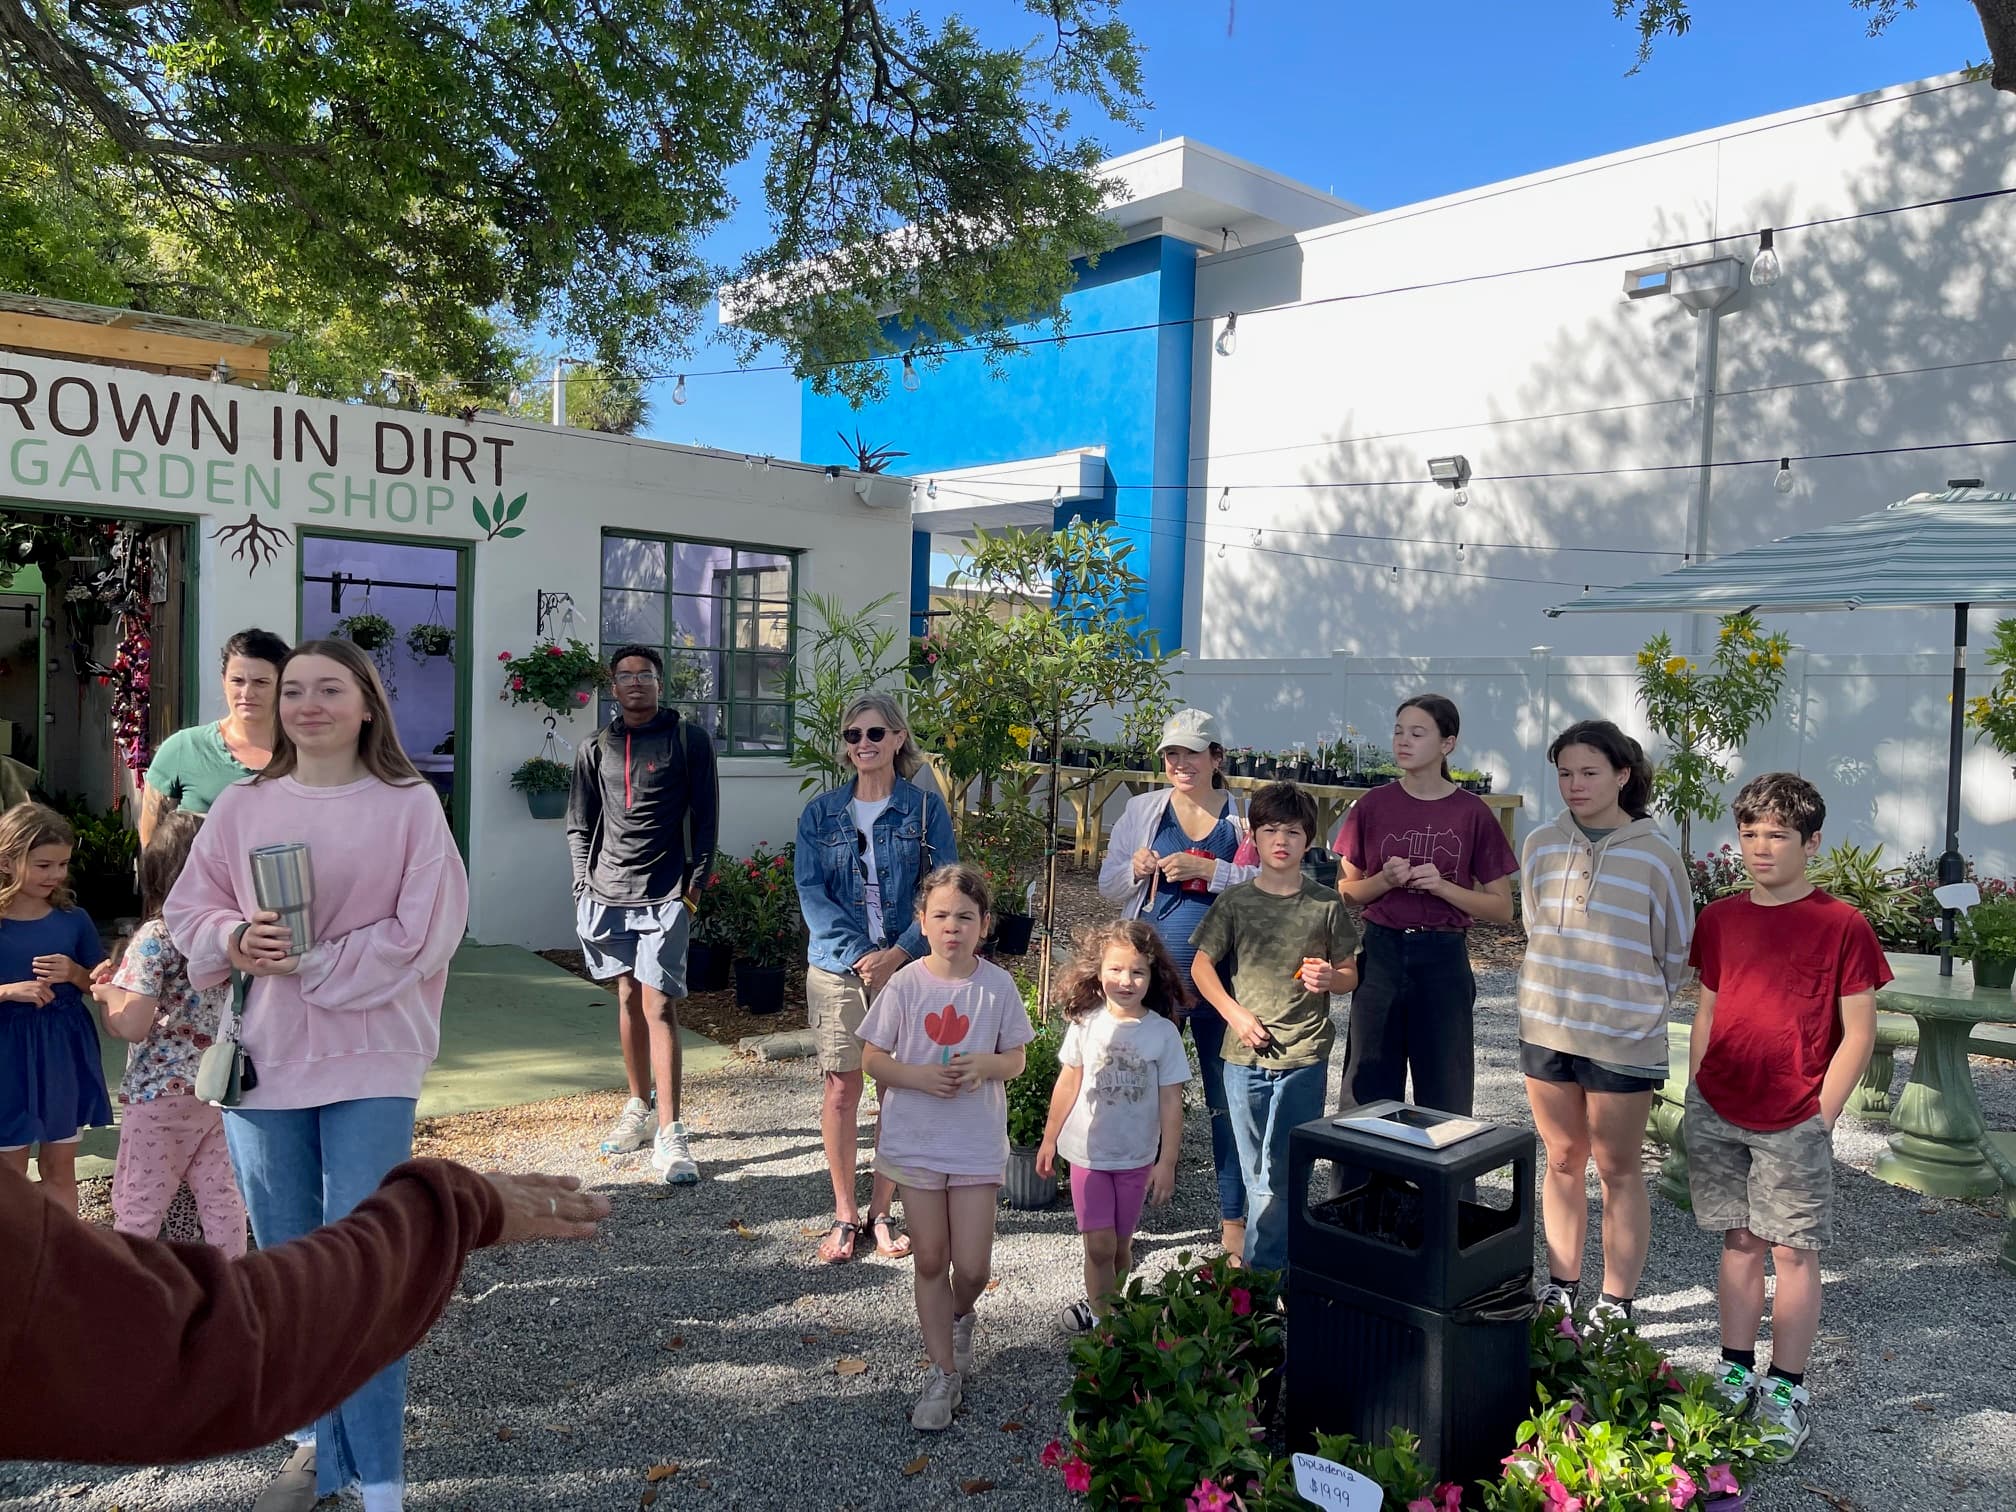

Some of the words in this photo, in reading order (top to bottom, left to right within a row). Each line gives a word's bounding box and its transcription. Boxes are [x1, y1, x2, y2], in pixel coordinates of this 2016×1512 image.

[0, 368, 238, 455] ROWN
[273, 406, 339, 467] IN
[375, 421, 514, 487] DIRT
[10, 438, 281, 510] GARDEN
[307, 472, 455, 525] SHOP
